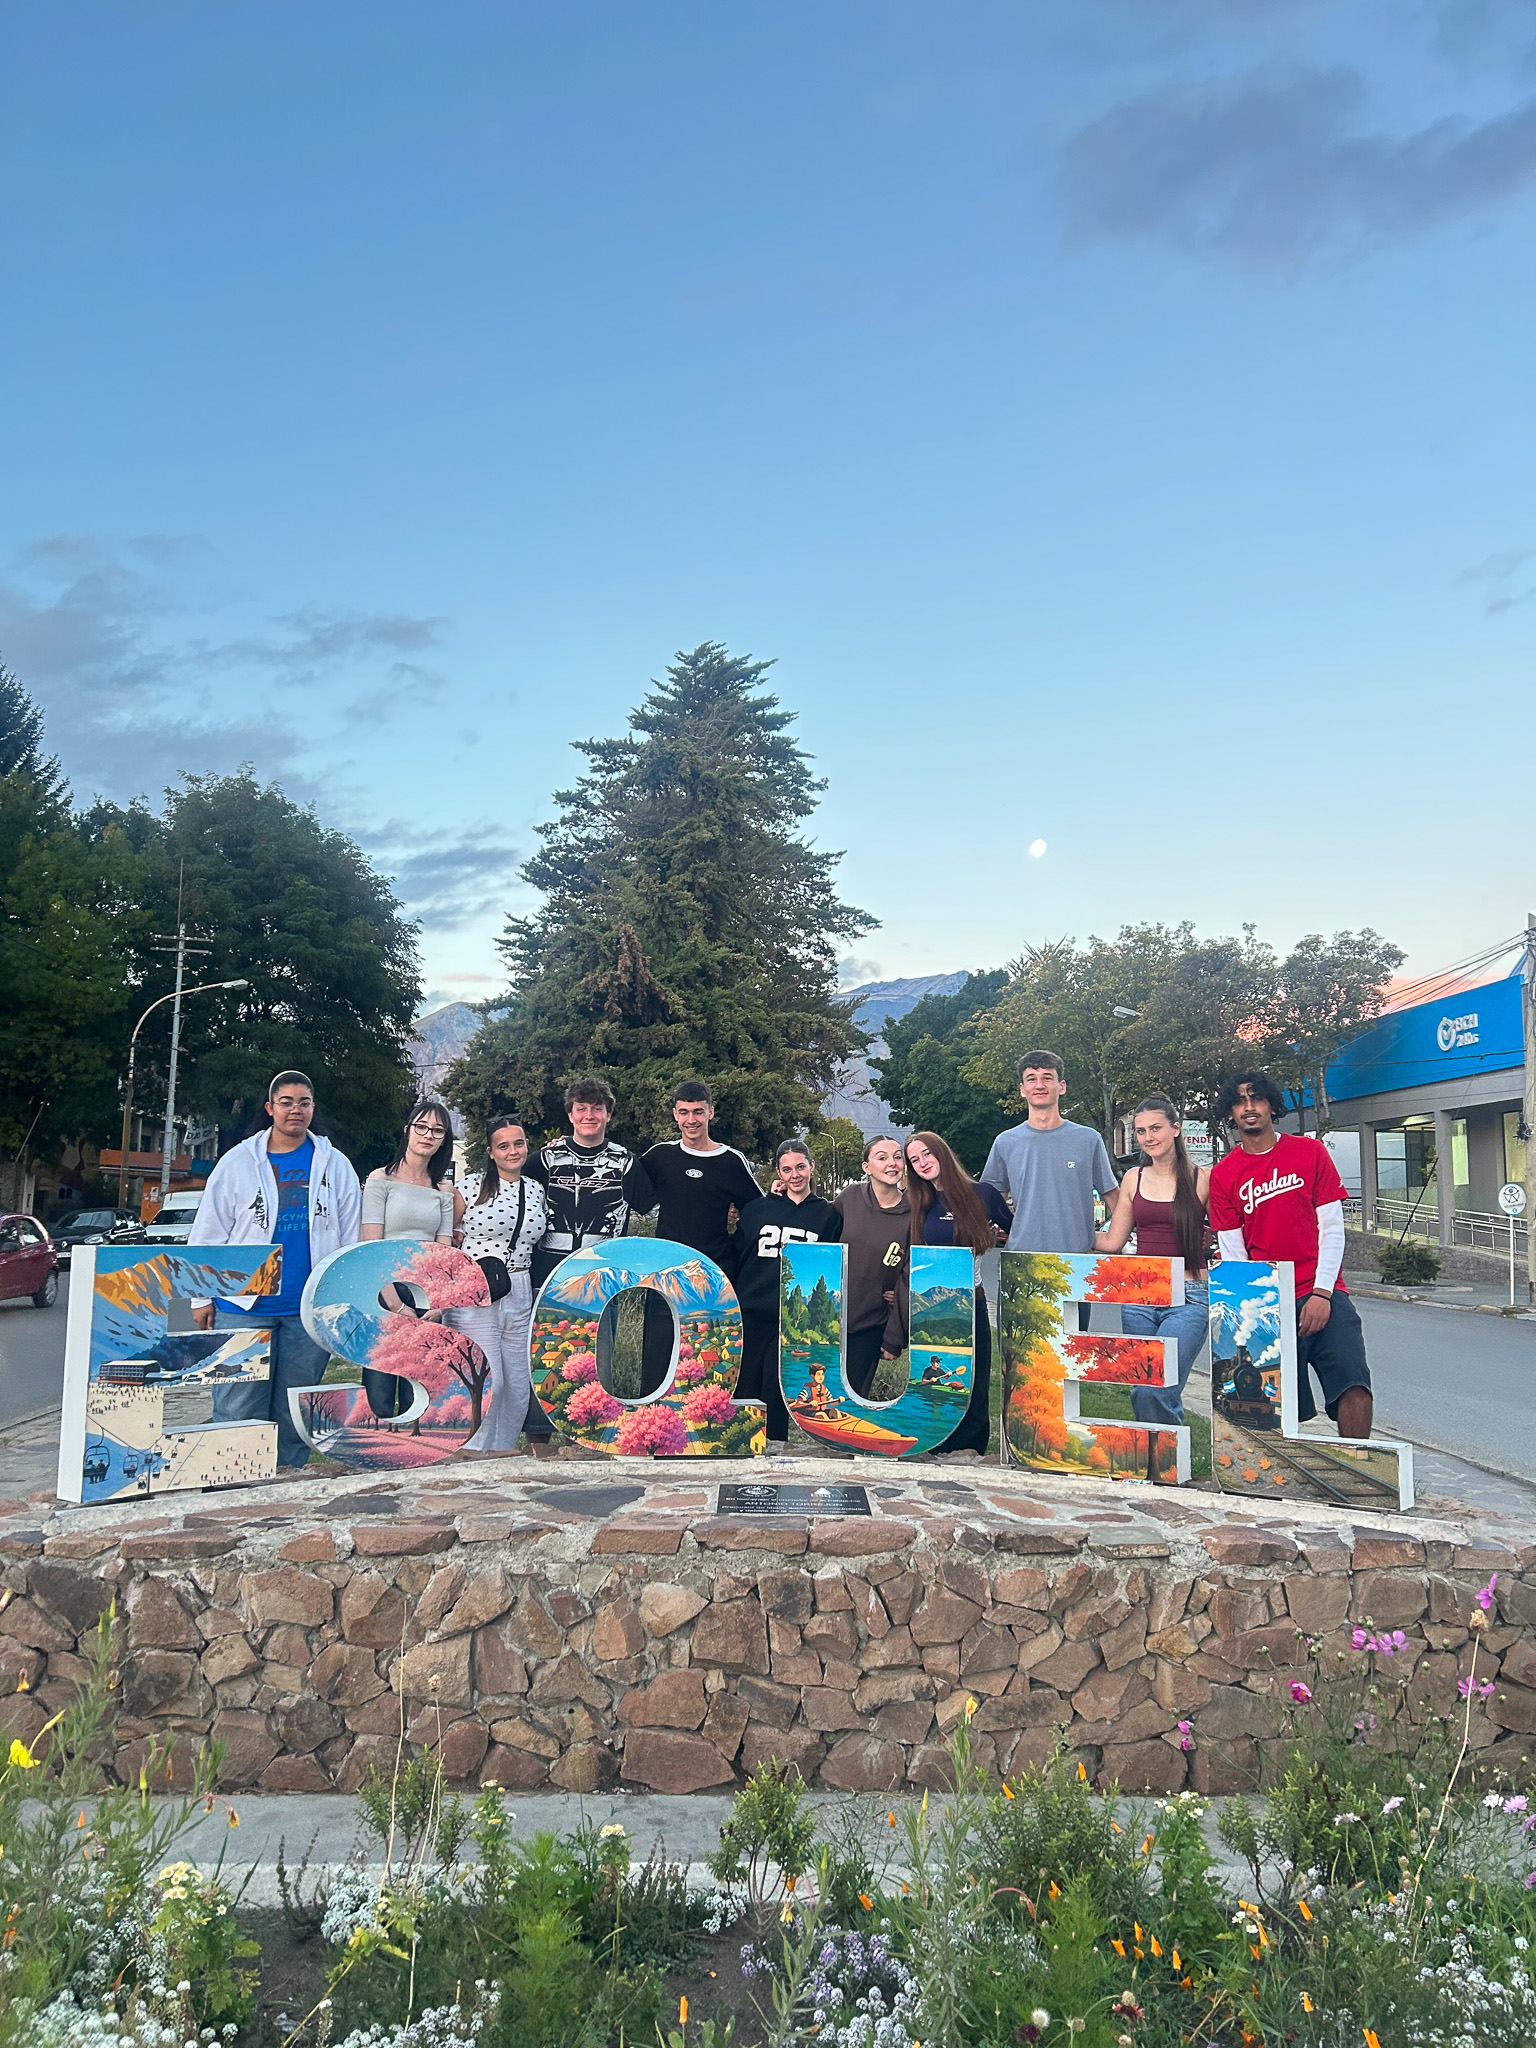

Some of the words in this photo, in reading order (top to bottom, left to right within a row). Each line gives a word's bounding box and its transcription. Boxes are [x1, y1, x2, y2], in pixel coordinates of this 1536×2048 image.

[1184, 1136, 1212, 1144] ENDE
[1239, 1168, 1304, 1214] Jordan
[278, 1223, 299, 1232] LIFE
[57, 1237, 1415, 1512] ESQUEL
